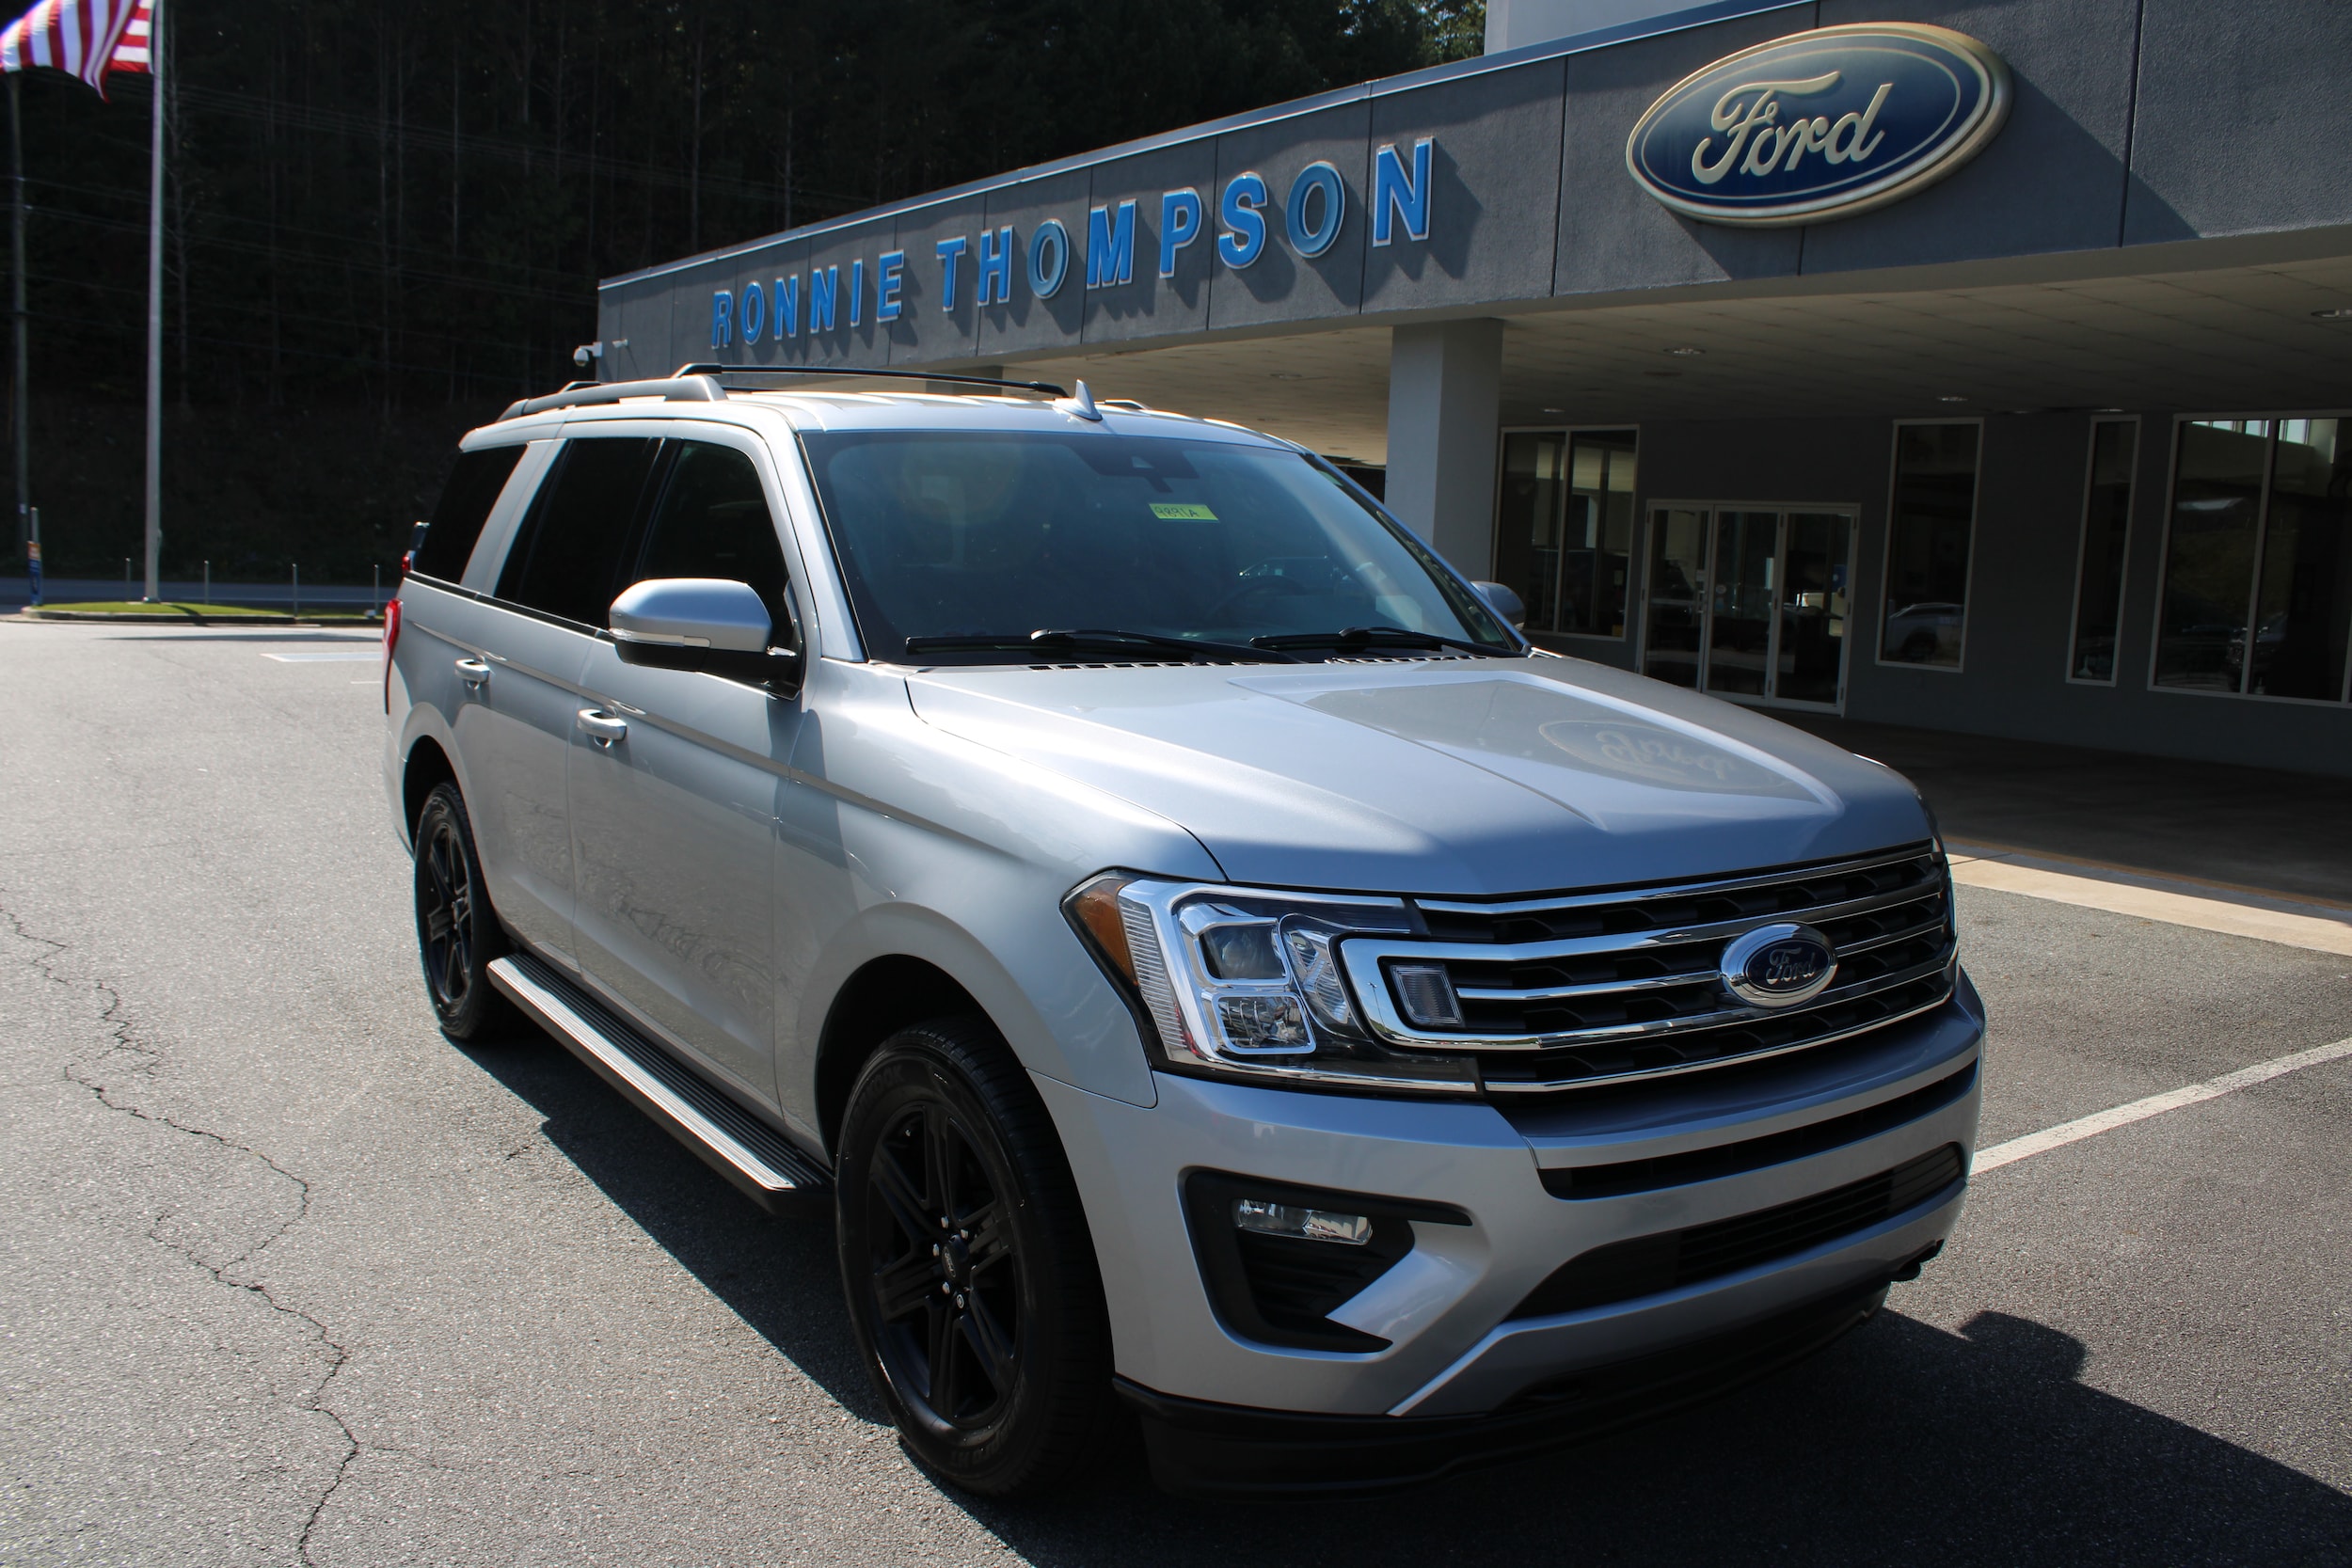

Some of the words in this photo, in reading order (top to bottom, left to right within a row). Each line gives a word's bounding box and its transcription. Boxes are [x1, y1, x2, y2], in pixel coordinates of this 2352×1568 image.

[1691, 71, 1894, 185] Ford
[710, 248, 904, 350] RONNIE
[935, 135, 1435, 312] THOMPSON
[1765, 947, 1816, 986] Ford
